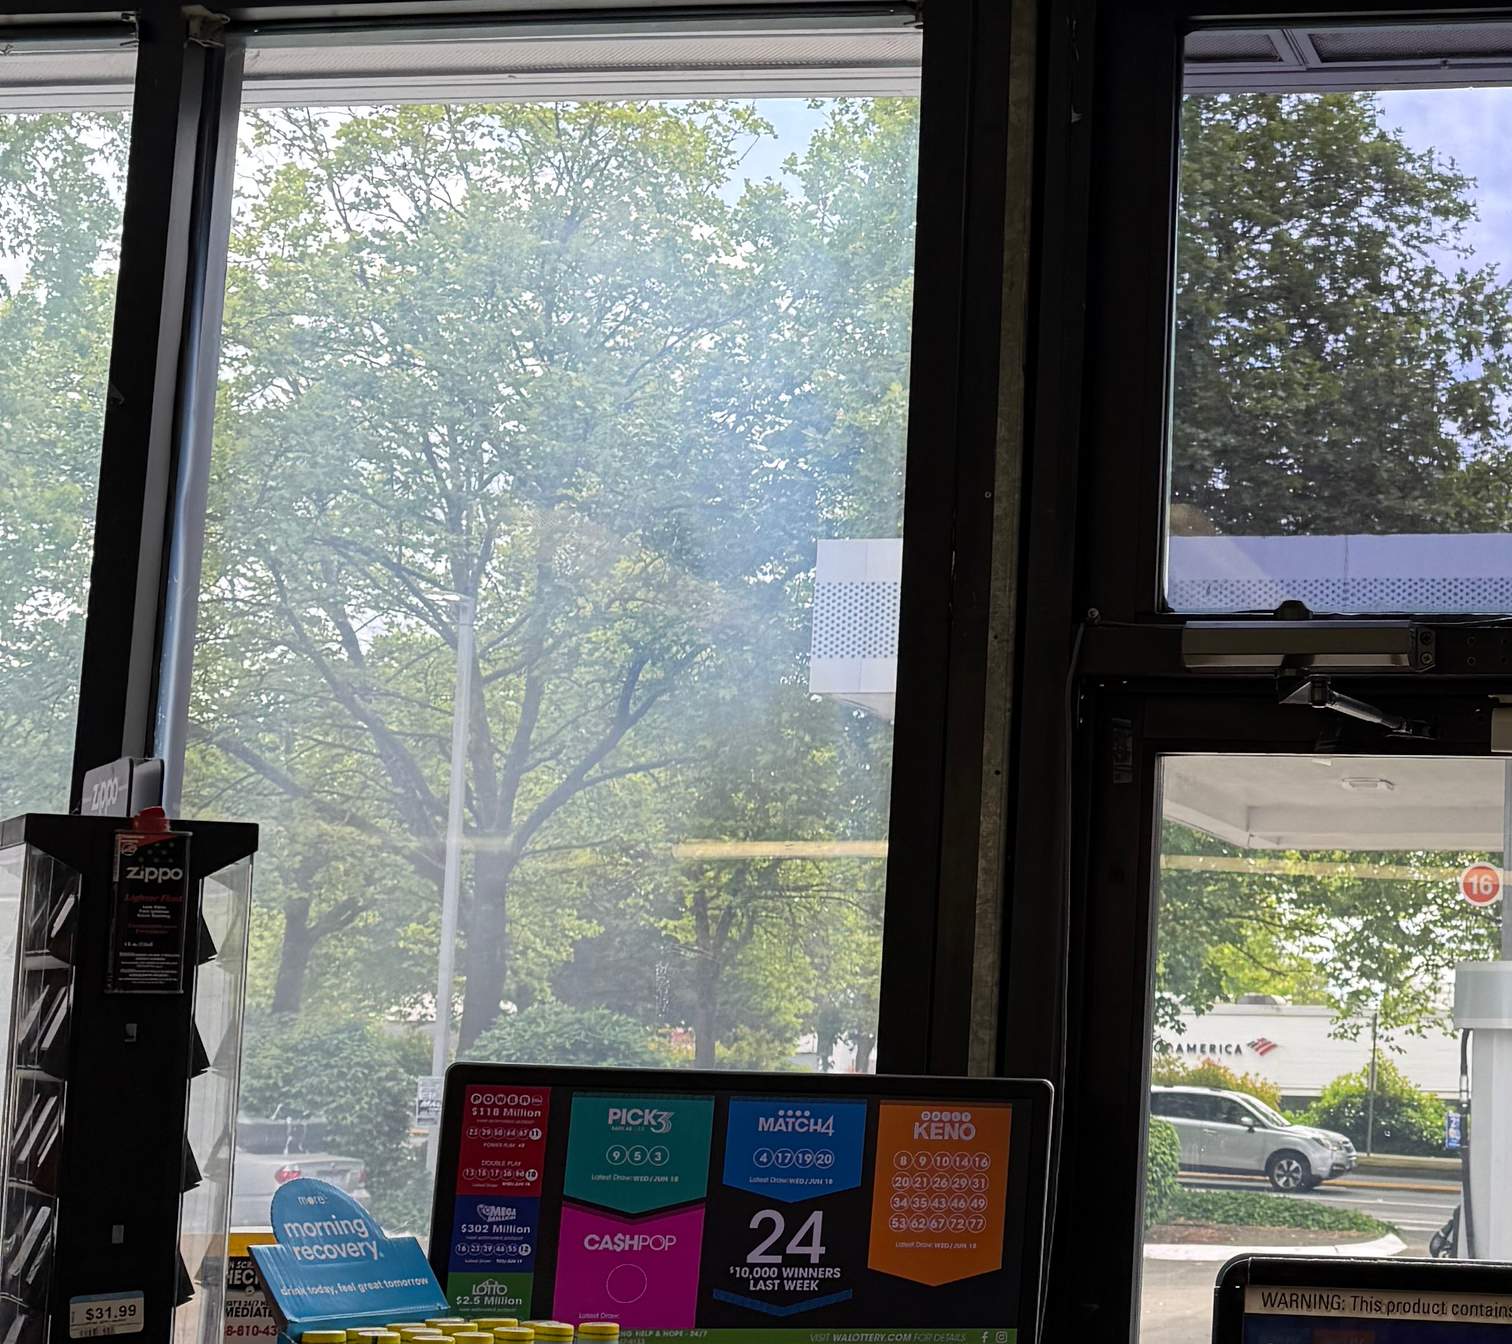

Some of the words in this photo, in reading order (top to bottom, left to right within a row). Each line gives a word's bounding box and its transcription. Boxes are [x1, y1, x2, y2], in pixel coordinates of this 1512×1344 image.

[1469, 874, 1493, 889] 16
[1175, 1043, 1243, 1055] AMERICA
[913, 1122, 977, 1141] KENO
[282, 1214, 369, 1239] morning
[460, 1223, 490, 1235] $302
[491, 1224, 532, 1235] Million
[745, 1208, 827, 1264] 24
[728, 1265, 778, 1280] $10,000
[781, 1266, 842, 1279] WINNERS
[749, 1279, 781, 1291] LAST
[783, 1279, 820, 1292] WEEK
[1261, 1291, 1346, 1312] WARNING:
[1350, 1295, 1382, 1313] This
[1386, 1298, 1447, 1316] product
[85, 1304, 137, 1321] $31.99
[809, 1333, 831, 1343] VISIT
[831, 1332, 912, 1344] WALOTTERY.COM
[913, 1333, 929, 1344] FOR
[929, 1333, 967, 1344] DETAILS
